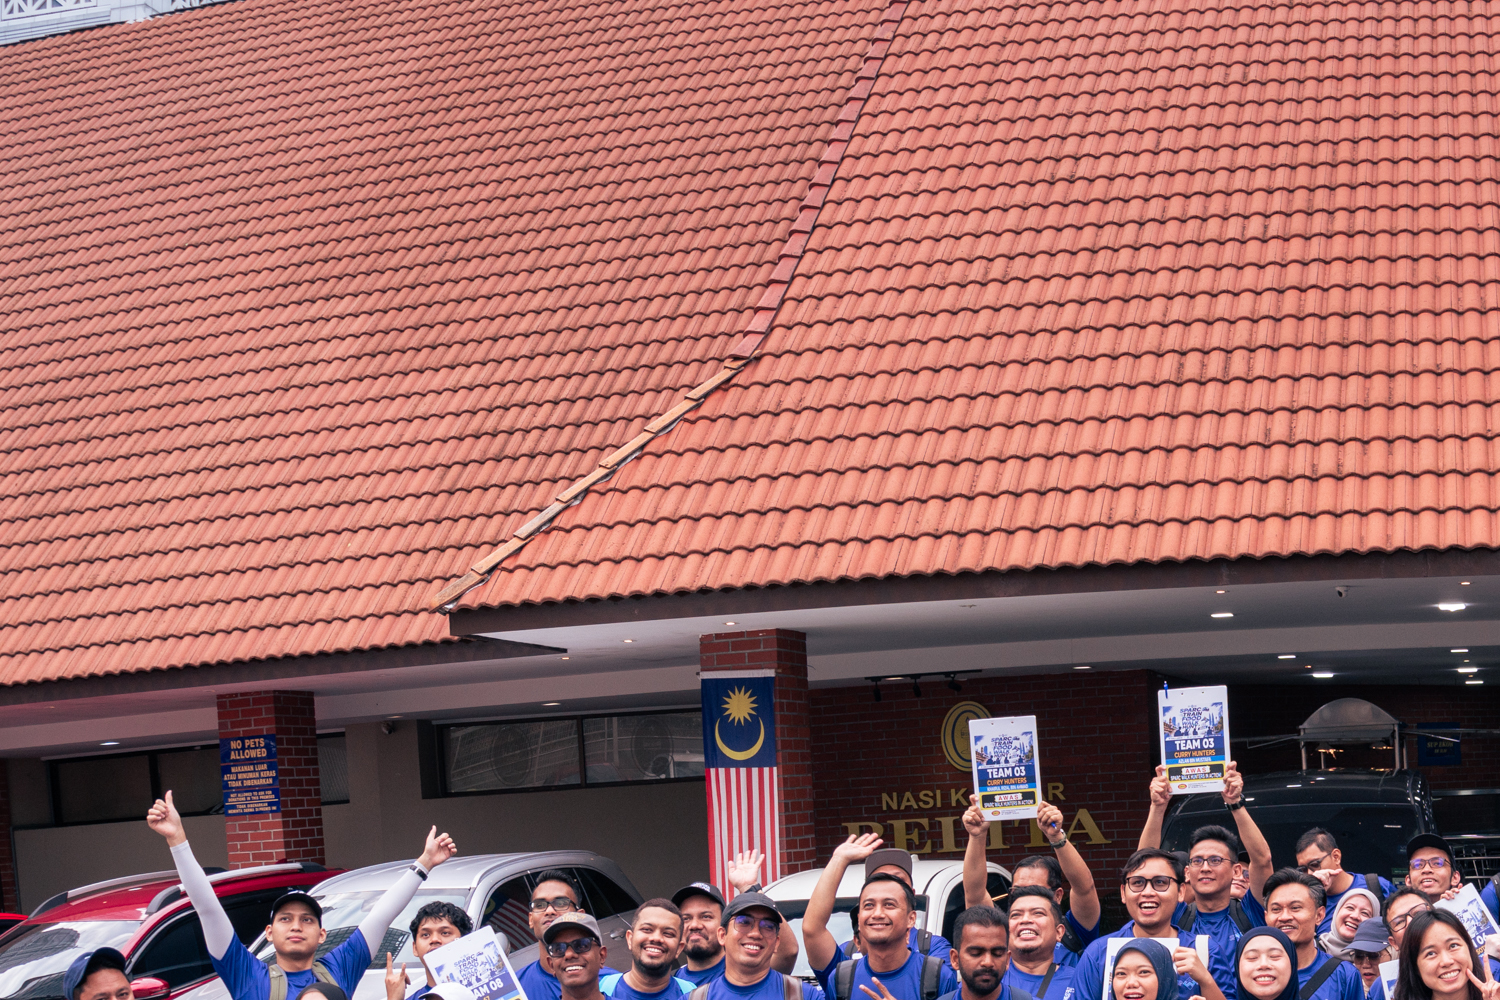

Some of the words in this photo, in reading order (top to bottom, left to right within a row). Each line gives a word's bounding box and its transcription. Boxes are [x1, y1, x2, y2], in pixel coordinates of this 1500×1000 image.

[230, 740, 242, 749] NO
[245, 738, 265, 748] PETS
[1175, 740, 1200, 750] TEAM
[1203, 738, 1214, 748] 03
[230, 749, 267, 759] ALLOWED
[987, 768, 1012, 778] TEAM
[1014, 766, 1025, 776] 03
[244, 778, 273, 786] DIBENARKAN
[882, 790, 942, 811] NASI
[454, 954, 475, 967] SPARC
[459, 958, 478, 969] TRAIN
[459, 962, 478, 974] FOOD
[490, 978, 504, 990] 08
